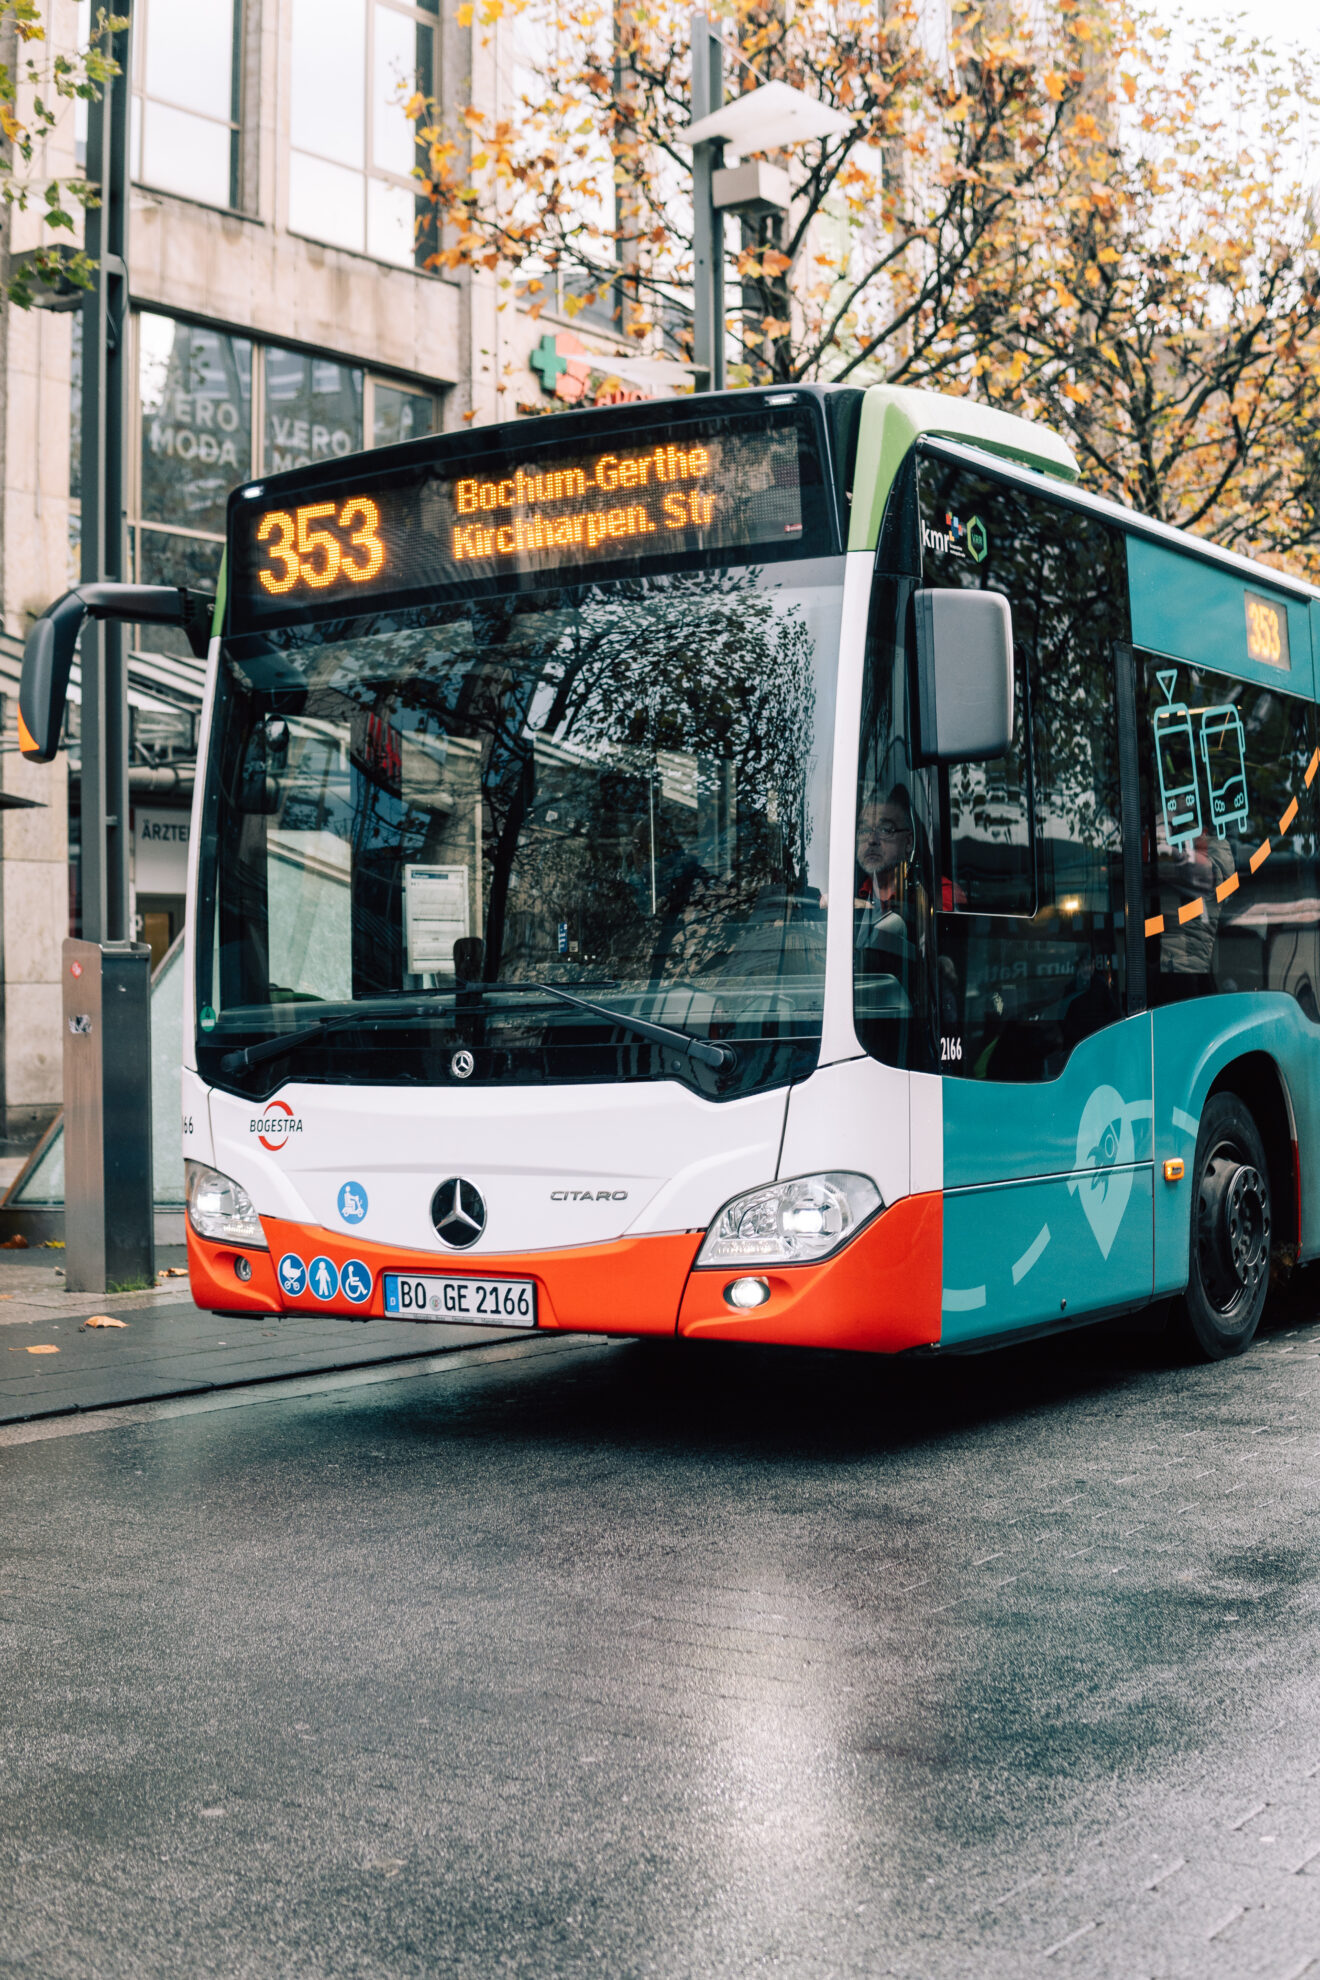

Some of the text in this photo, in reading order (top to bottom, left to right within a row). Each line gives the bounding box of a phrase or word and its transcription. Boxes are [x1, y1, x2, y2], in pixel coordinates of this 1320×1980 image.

[150, 420, 239, 469] MODA
[271, 414, 352, 456] VERO
[456, 445, 709, 514] Bochum-Gerthe
[257, 497, 384, 594] 353
[453, 489, 716, 560] Kirchharpen. Str
[921, 519, 950, 553] kmr
[1248, 602, 1281, 662] 353
[940, 1037, 962, 1060] 2166
[250, 1119, 303, 1132] BOGESTRA
[550, 1191, 629, 1201] CITARO
[400, 1280, 530, 1315] BO GE 2166
